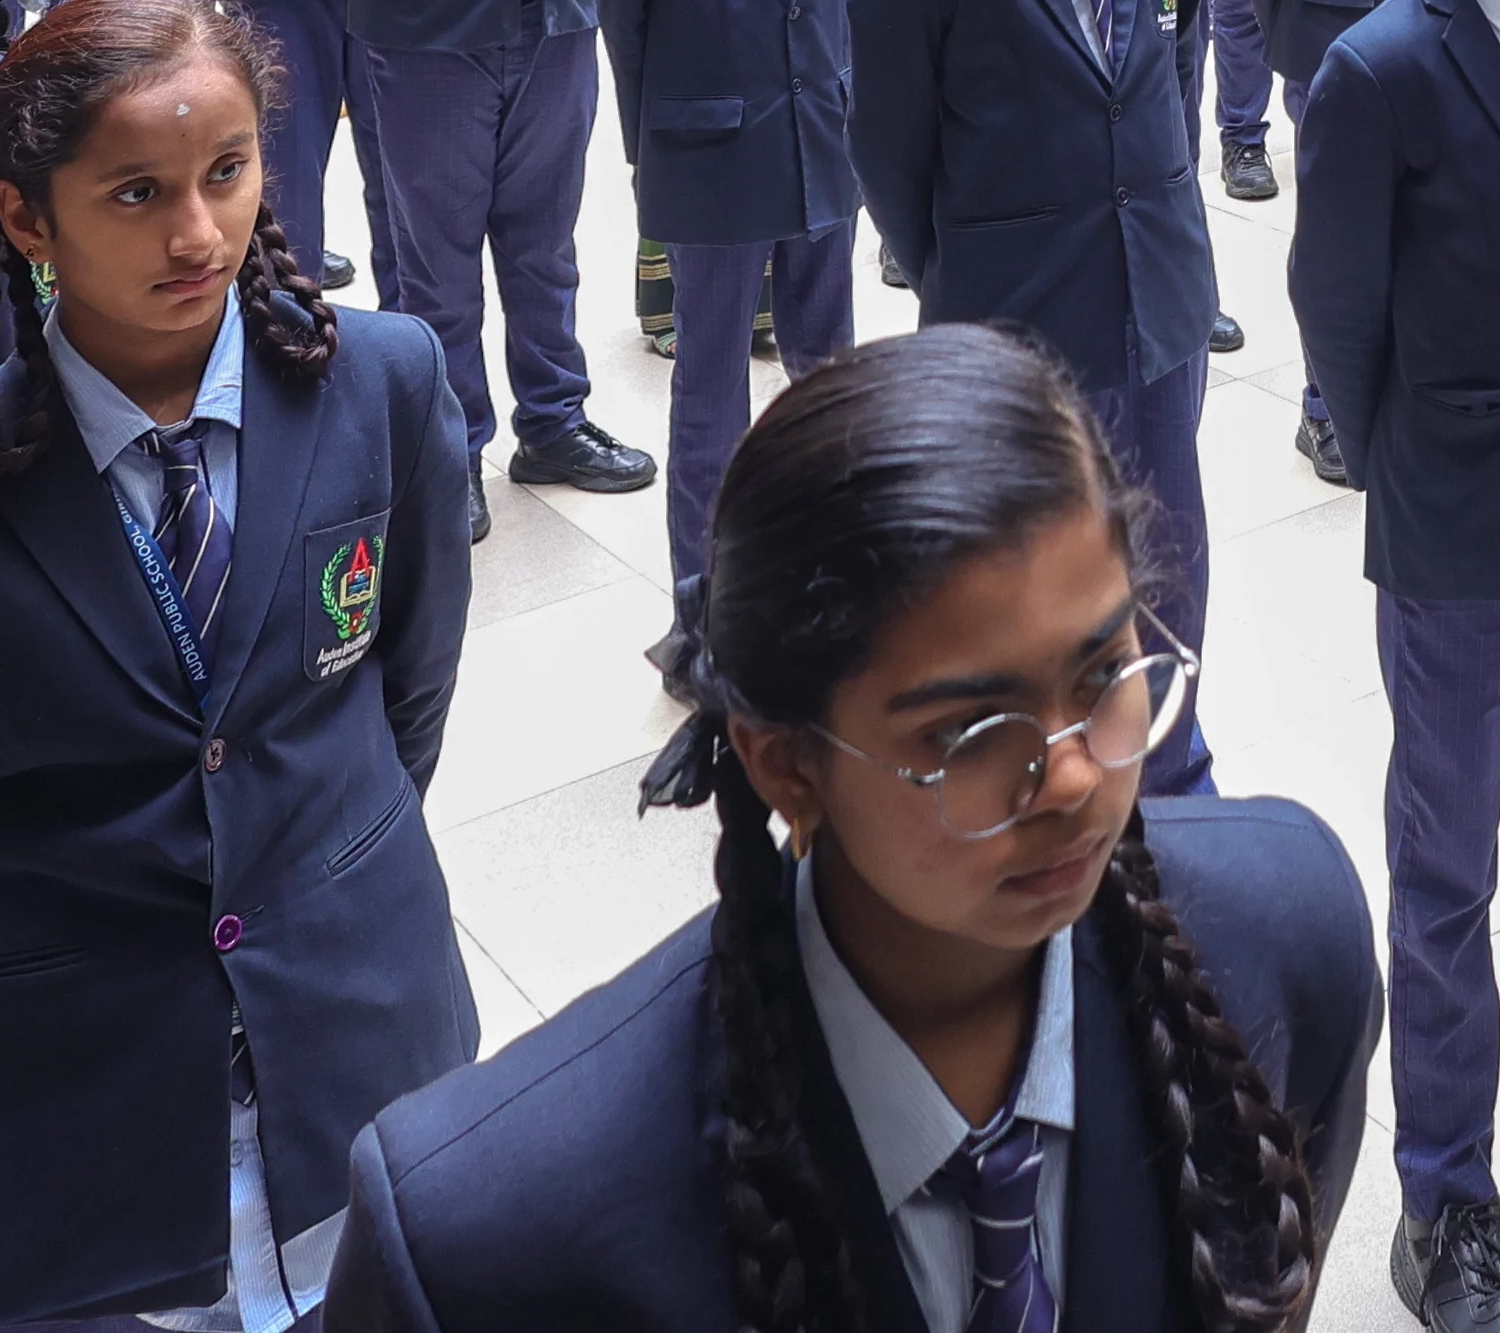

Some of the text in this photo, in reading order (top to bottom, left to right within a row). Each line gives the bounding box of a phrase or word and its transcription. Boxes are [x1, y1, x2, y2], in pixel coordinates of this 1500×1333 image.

[132, 524, 207, 682] AUDEN PUBLIC SCHOOL,
[320, 662, 332, 677] of
